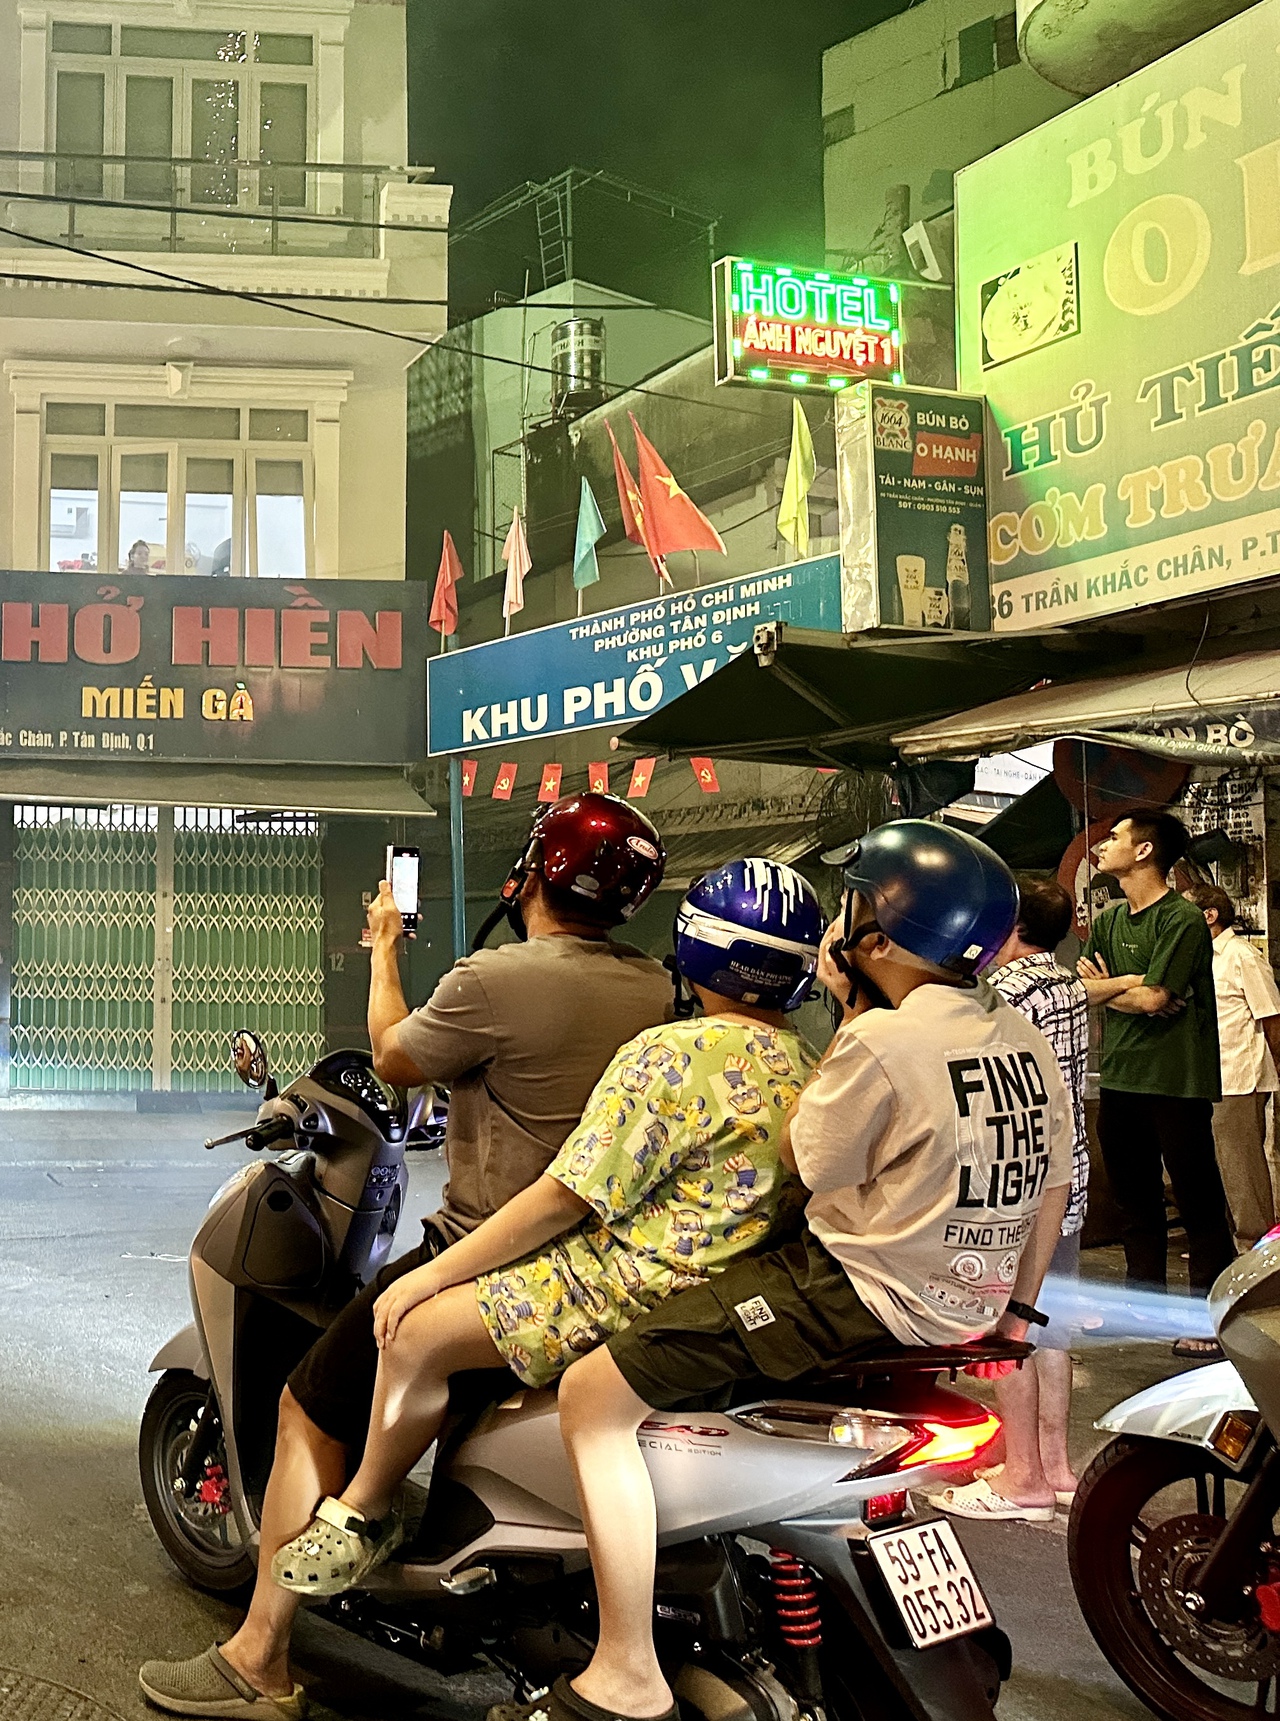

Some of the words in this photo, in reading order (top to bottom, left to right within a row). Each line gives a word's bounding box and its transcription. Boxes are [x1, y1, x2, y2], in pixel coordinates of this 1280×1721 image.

[1066, 63, 1247, 209] BÚN
[741, 272, 890, 331] HOTEL
[743, 315, 791, 352] ÁNH
[795, 327, 878, 366] NGUYỆT
[880, 338, 891, 364] 1
[876, 436, 911, 450] BLANC
[880, 412, 902, 426] 1664
[917, 410, 946, 428] BÚN
[1002, 379, 1111, 481] HỦ
[916, 443, 928, 456] O
[932, 444, 976, 464] HẠNH
[879, 473, 894, 486] TÁI
[904, 478, 926, 490] NẠM
[964, 485, 984, 496] SỤN
[989, 483, 1108, 565] CƠM
[1022, 577, 1078, 613] TRẦN
[1086, 558, 1148, 599] KHẮC
[1156, 544, 1232, 580] CHÂN,
[172, 585, 404, 669] HIỀN
[569, 615, 624, 640] THÀNH
[630, 602, 666, 626] PHỐ
[670, 593, 696, 616] HỒ
[701, 590, 734, 608] CHÍ
[740, 572, 792, 599] MINH
[594, 626, 665, 652] PHƯỜNG
[670, 614, 707, 634] TÂN
[712, 601, 760, 626] ĐỊNH
[627, 644, 664, 662] KHU
[668, 628, 706, 654] PHỐ
[711, 630, 723, 644] 6
[82, 674, 184, 719] MIẾN
[201, 682, 255, 721] GÀ
[462, 692, 548, 743] KHU
[563, 656, 670, 724] PHỐ
[60, 731, 68, 747] P.
[72, 730, 96, 748] Tân
[102, 732, 132, 751] Định,
[136, 733, 154, 751] Q.1
[1206, 713, 1255, 748] BÒ
[329, 953, 344, 971] 12
[947, 1052, 1048, 1118] FIND
[986, 1109, 1044, 1160] THE
[956, 1154, 1049, 1208] LIGHT
[944, 1224, 994, 1246] FIND
[998, 1224, 1022, 1245] THE
[740, 1306, 756, 1325] LIGHT
[752, 1300, 770, 1321] FIND
[883, 1528, 957, 1584] 59-FA
[902, 1576, 986, 1638] 055.32
